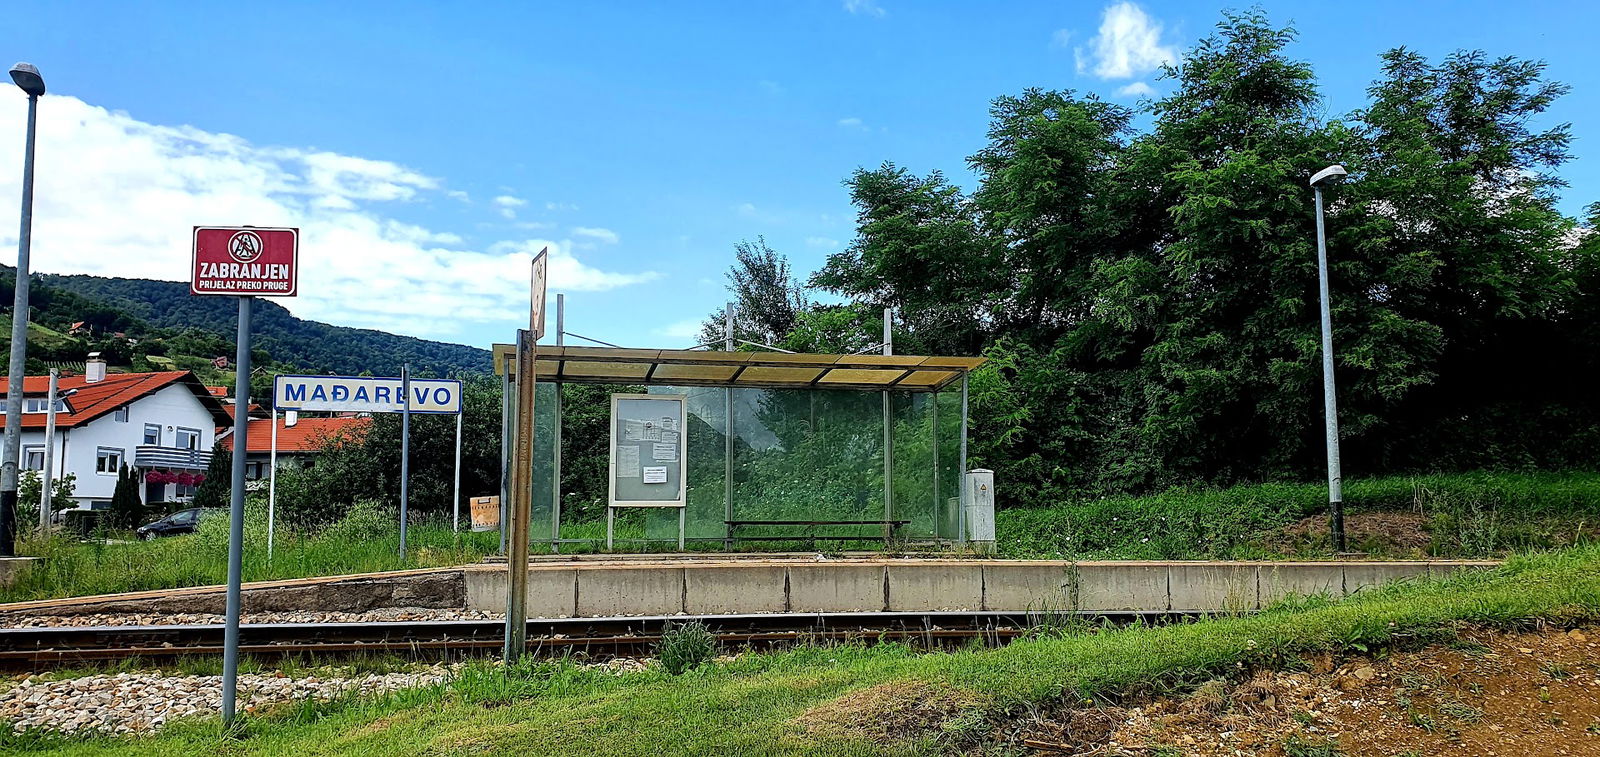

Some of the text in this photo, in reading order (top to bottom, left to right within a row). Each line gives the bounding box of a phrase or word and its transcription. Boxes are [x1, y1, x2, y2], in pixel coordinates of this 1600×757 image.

[200, 262, 289, 279] ZABRANJEN
[199, 280, 288, 290] PRIJELAZ PREKO PRUGE
